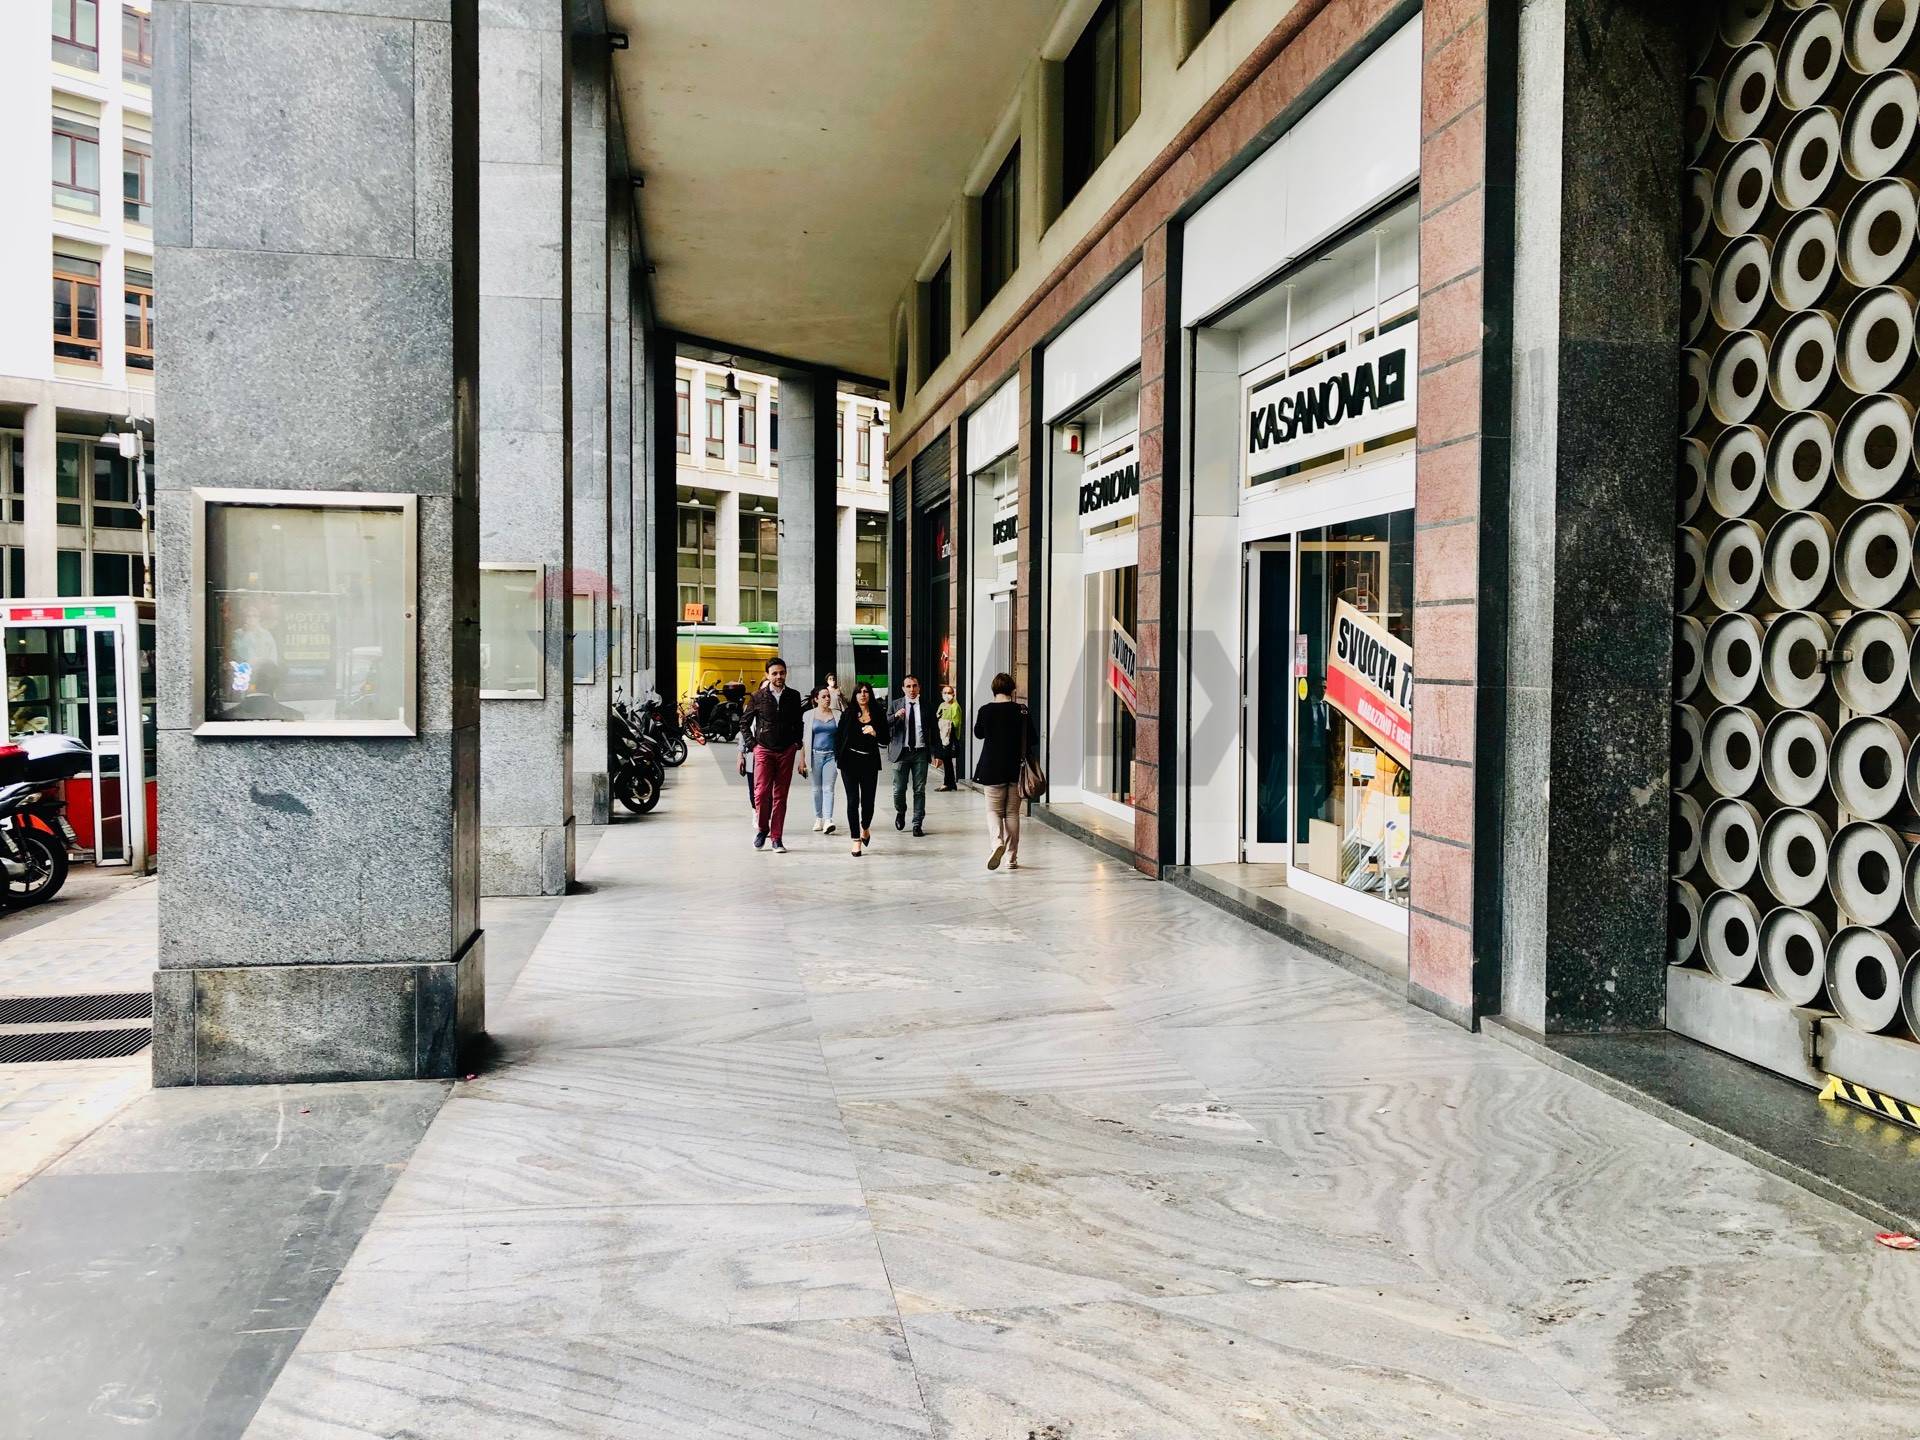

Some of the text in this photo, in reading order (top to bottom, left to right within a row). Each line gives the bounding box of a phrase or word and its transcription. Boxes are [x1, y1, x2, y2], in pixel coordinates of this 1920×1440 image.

[1249, 362, 1379, 454] KASANOVA
[687, 608, 702, 617] TAXI
[1112, 628, 1136, 681] SVUOTA
[1337, 617, 1397, 699] SVUOTA
[1399, 662, 1412, 712] T
